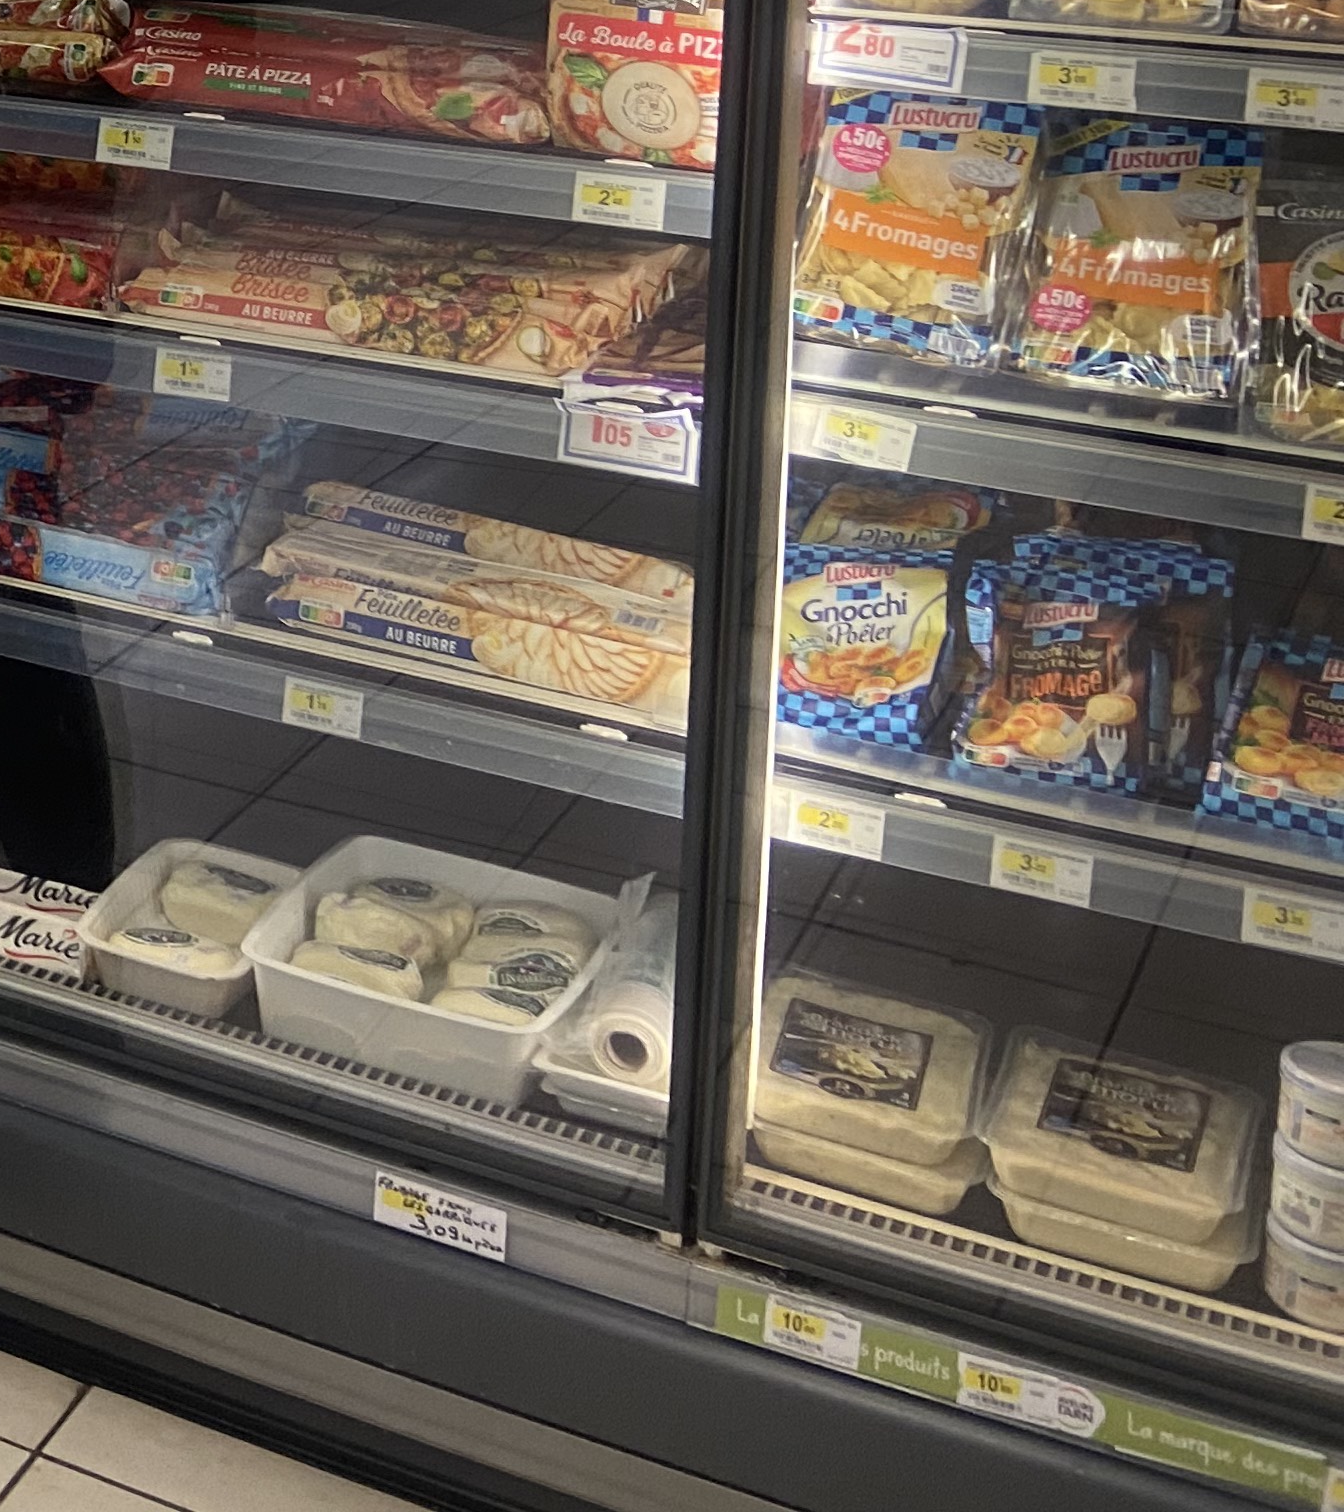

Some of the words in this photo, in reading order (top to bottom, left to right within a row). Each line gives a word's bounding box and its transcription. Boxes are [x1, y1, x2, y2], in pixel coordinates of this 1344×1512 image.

[145, 25, 203, 42] Casino
[559, 24, 588, 48] La
[589, 22, 653, 54] Boule
[657, 34, 674, 55] à
[205, 59, 243, 80] PÂTE
[262, 66, 312, 87] PIZZA
[892, 102, 979, 129] Lustucru
[1111, 150, 1200, 173] Lustucru
[231, 273, 310, 304] Brisée
[241, 303, 261, 317] AU
[262, 305, 313, 326] BEURRE
[383, 520, 400, 534] AU
[401, 525, 452, 547] BEURRE
[825, 563, 897, 583] Lustucru
[354, 589, 461, 631] Feuilletée
[800, 592, 908, 625] Gnocchi
[385, 626, 404, 641] AU
[406, 629, 458, 656] BEURRE
[833, 620, 897, 647] Poêler
[1013, 669, 1103, 698] FROMAGE
[736, 1298, 761, 1327] La
[874, 1342, 952, 1382] produits
[1126, 1410, 1154, 1438] La
[1159, 1429, 1234, 1466] marque
